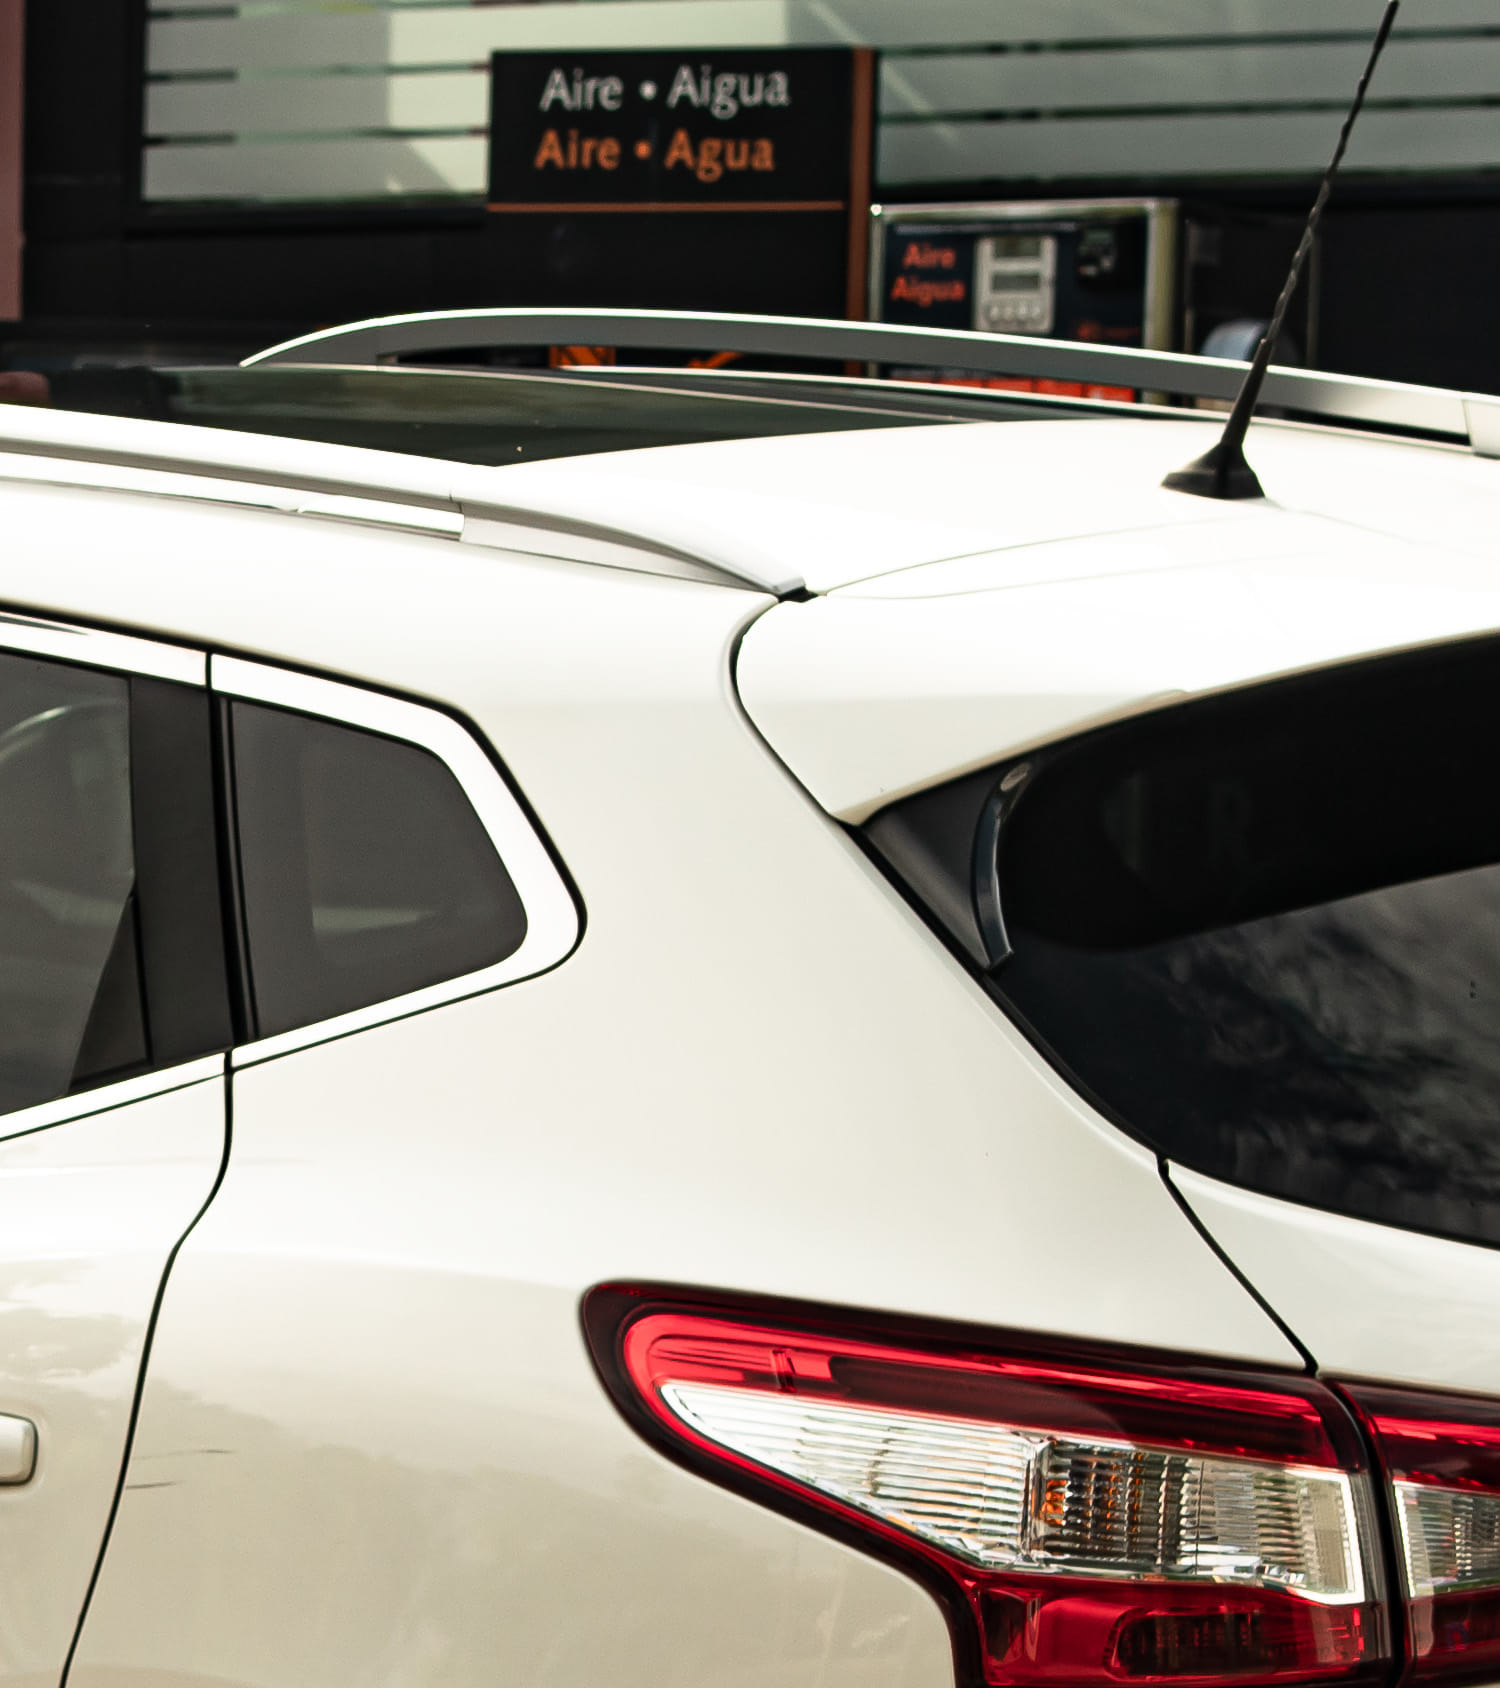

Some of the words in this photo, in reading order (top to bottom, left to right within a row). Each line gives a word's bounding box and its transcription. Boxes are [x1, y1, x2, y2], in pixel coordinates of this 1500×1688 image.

[538, 68, 624, 111] Aire
[666, 65, 791, 119] Aigua
[534, 128, 621, 169] Aire
[664, 128, 774, 183] Agua
[903, 242, 956, 269] Aire
[891, 275, 966, 307] Aigua
